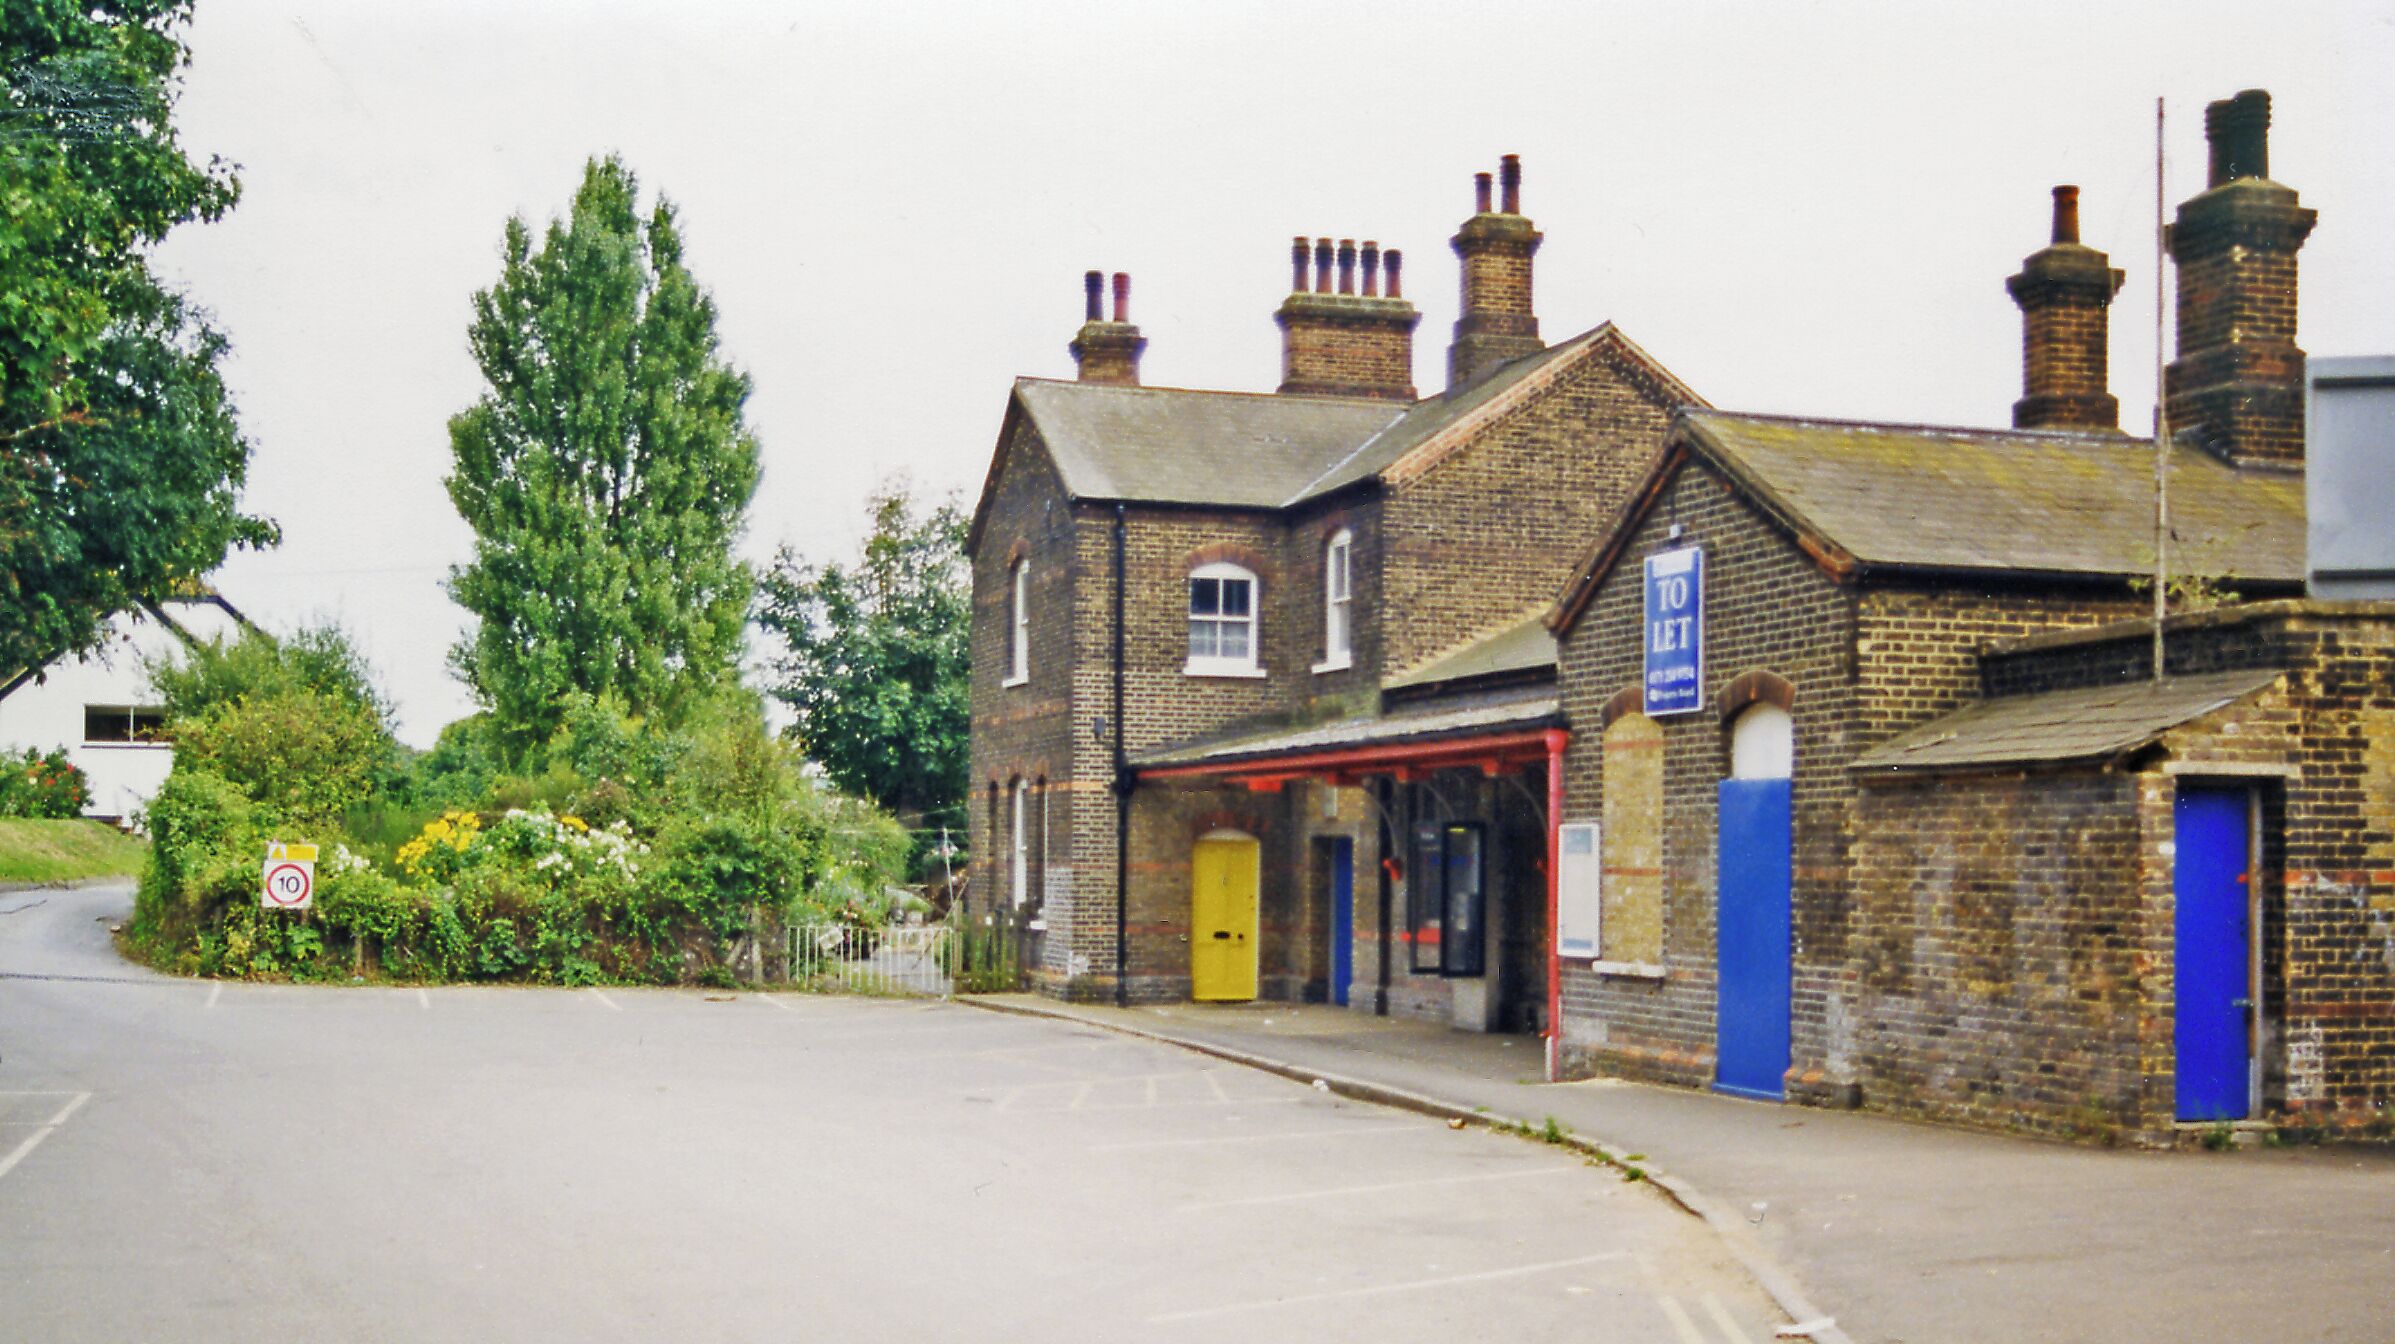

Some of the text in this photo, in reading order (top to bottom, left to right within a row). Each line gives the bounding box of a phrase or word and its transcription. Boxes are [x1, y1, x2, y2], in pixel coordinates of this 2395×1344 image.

[1656, 576, 1688, 612] TO
[1653, 616, 1692, 653] LET
[278, 875, 301, 894] 10
